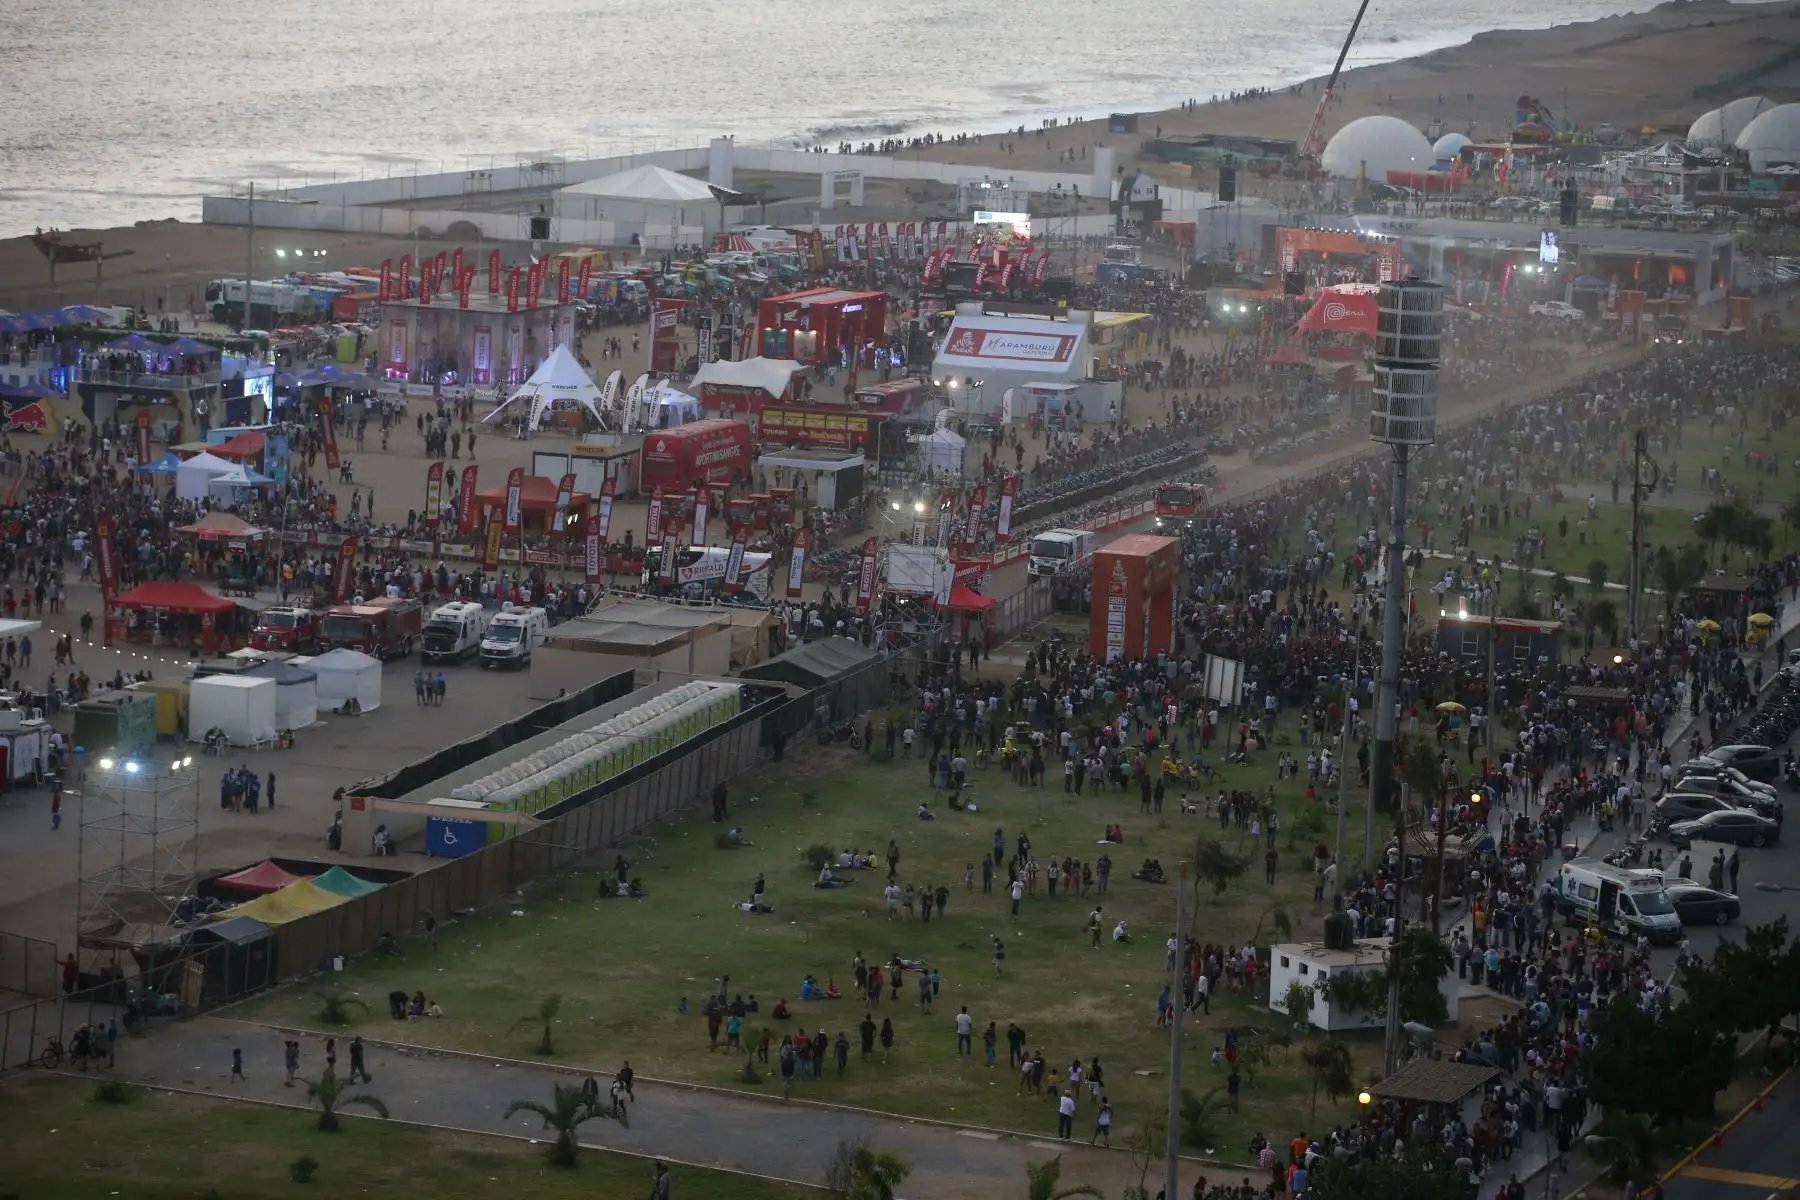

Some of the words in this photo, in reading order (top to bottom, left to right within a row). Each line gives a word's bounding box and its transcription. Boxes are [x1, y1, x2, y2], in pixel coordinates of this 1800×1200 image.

[924, 255, 935, 277] MOTUL
[977, 262, 987, 285] MOTUL
[1002, 263, 1012, 286] MOTUL
[1036, 257, 1047, 279] MOTUL
[1000, 341, 1055, 351] ARAMBURU
[650, 506, 659, 534] MOTUL
[969, 508, 979, 539] MOTUL
[862, 562, 872, 592] MOTUL
